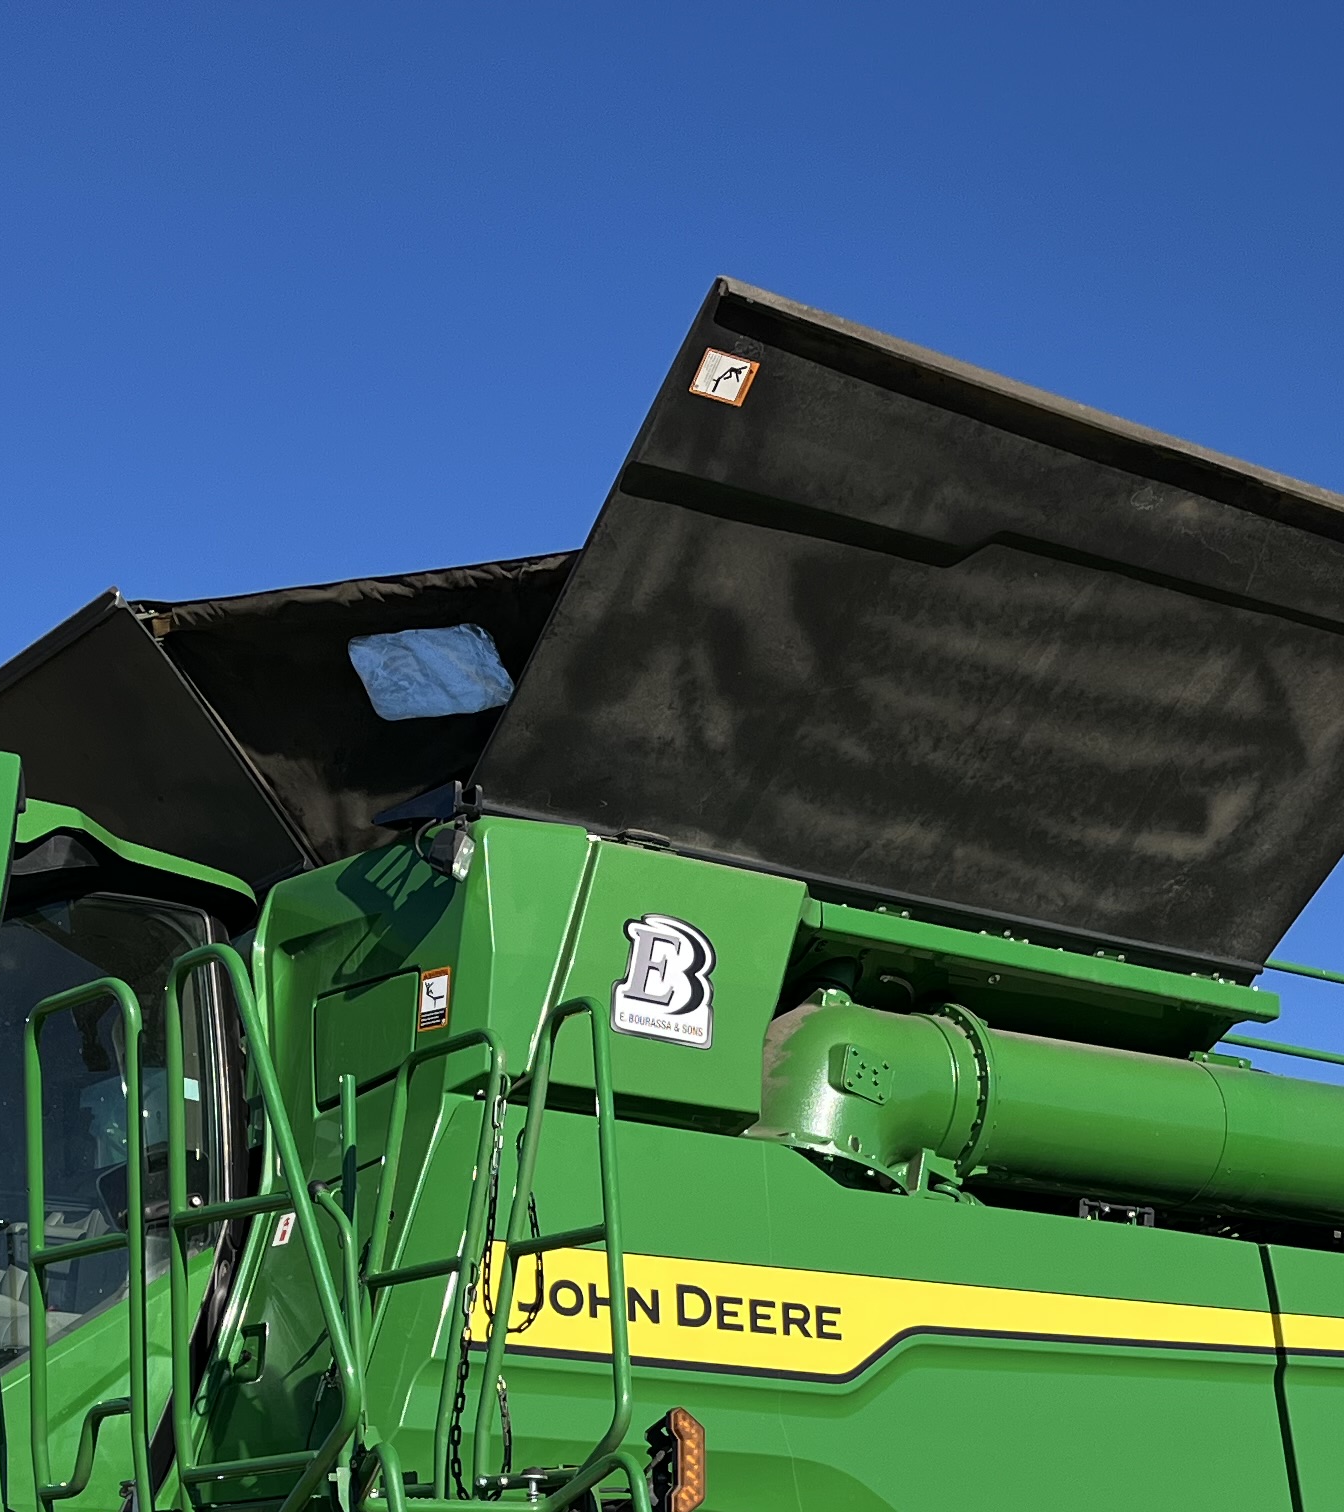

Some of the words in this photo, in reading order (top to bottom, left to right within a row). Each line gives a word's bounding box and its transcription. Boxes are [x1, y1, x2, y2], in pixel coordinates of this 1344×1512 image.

[628, 1013, 672, 1031] BOURASSA
[674, 1023, 680, 1033] &
[682, 1024, 704, 1037] SONS
[517, 1267, 660, 1325] JOHN
[676, 1283, 843, 1341] DEERE
